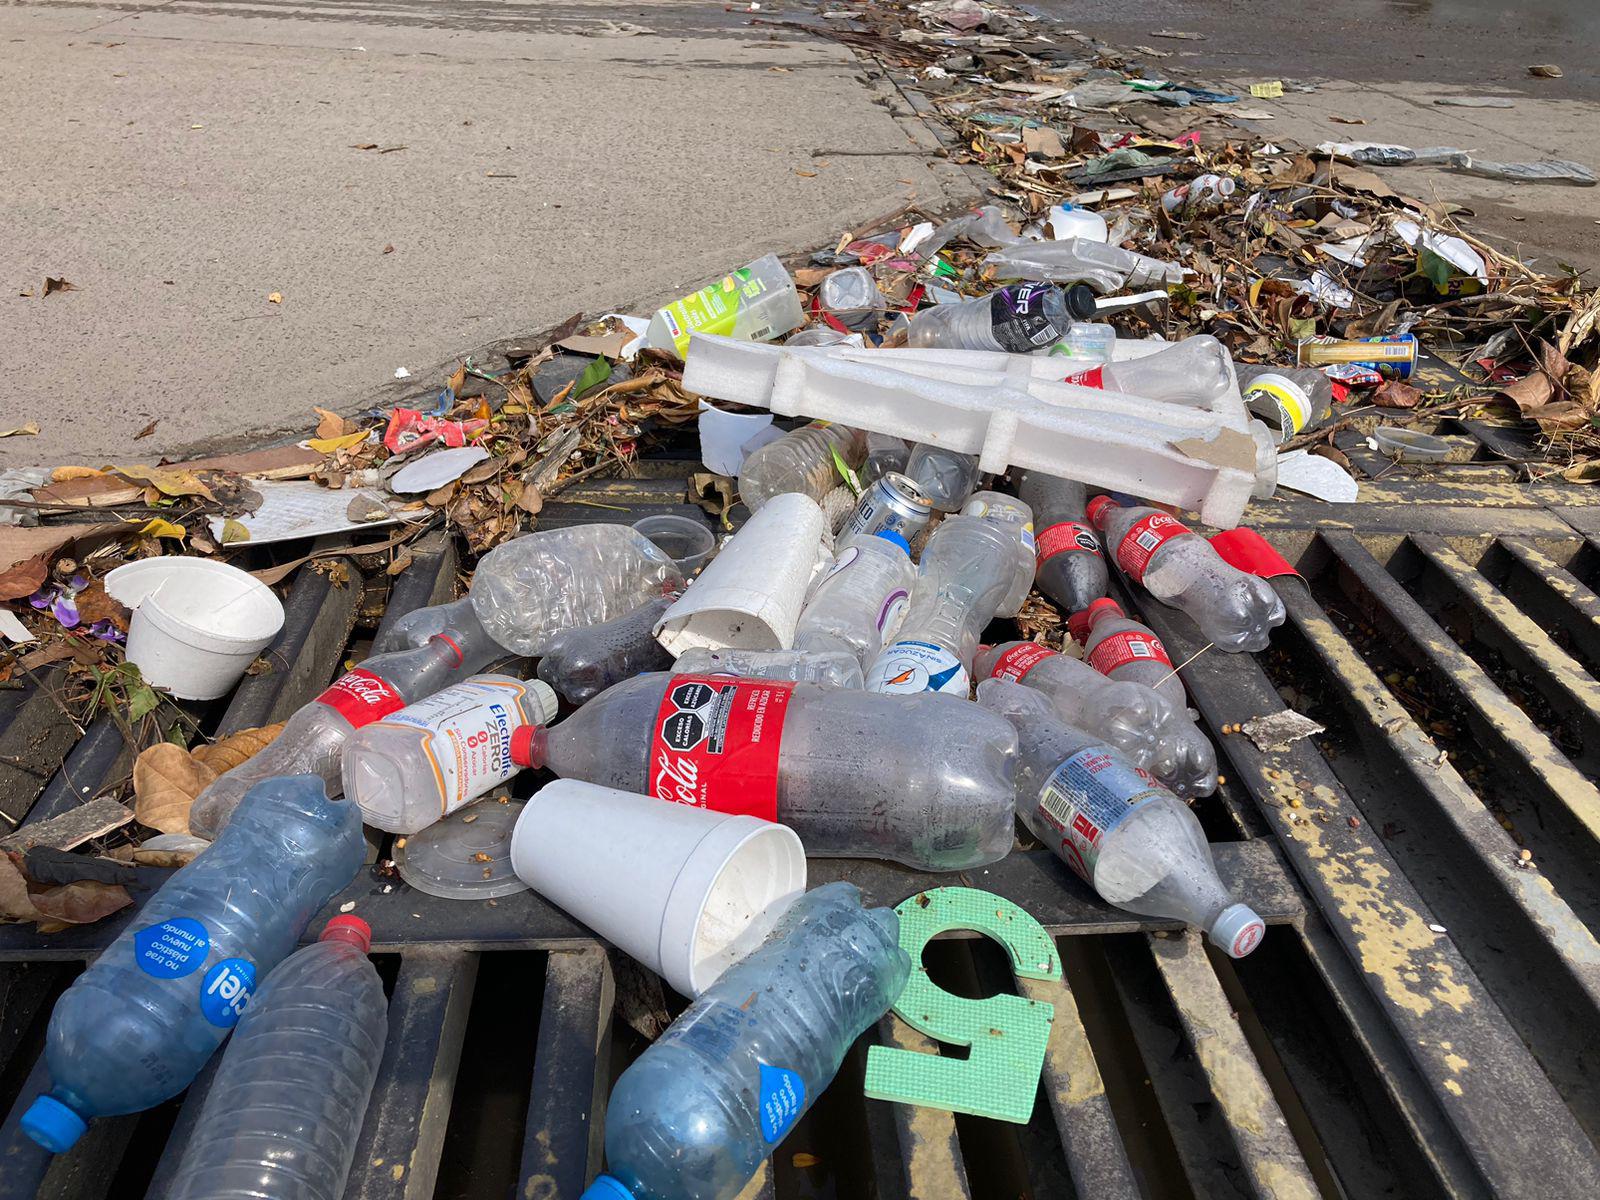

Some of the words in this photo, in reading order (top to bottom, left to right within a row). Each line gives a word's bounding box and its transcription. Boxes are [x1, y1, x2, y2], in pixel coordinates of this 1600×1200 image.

[683, 686, 695, 704] EXCESO
[675, 717, 685, 743] EXCESO
[682, 715, 693, 746] CALORÍAS
[485, 719, 502, 773] ZERO
[489, 703, 512, 777] Electrolife
[162, 923, 195, 942] mundo
[151, 941, 189, 963] plástico
[161, 934, 192, 952] nuevo
[194, 939, 206, 948] al
[145, 950, 165, 964] trae
[164, 960, 180, 971] no
